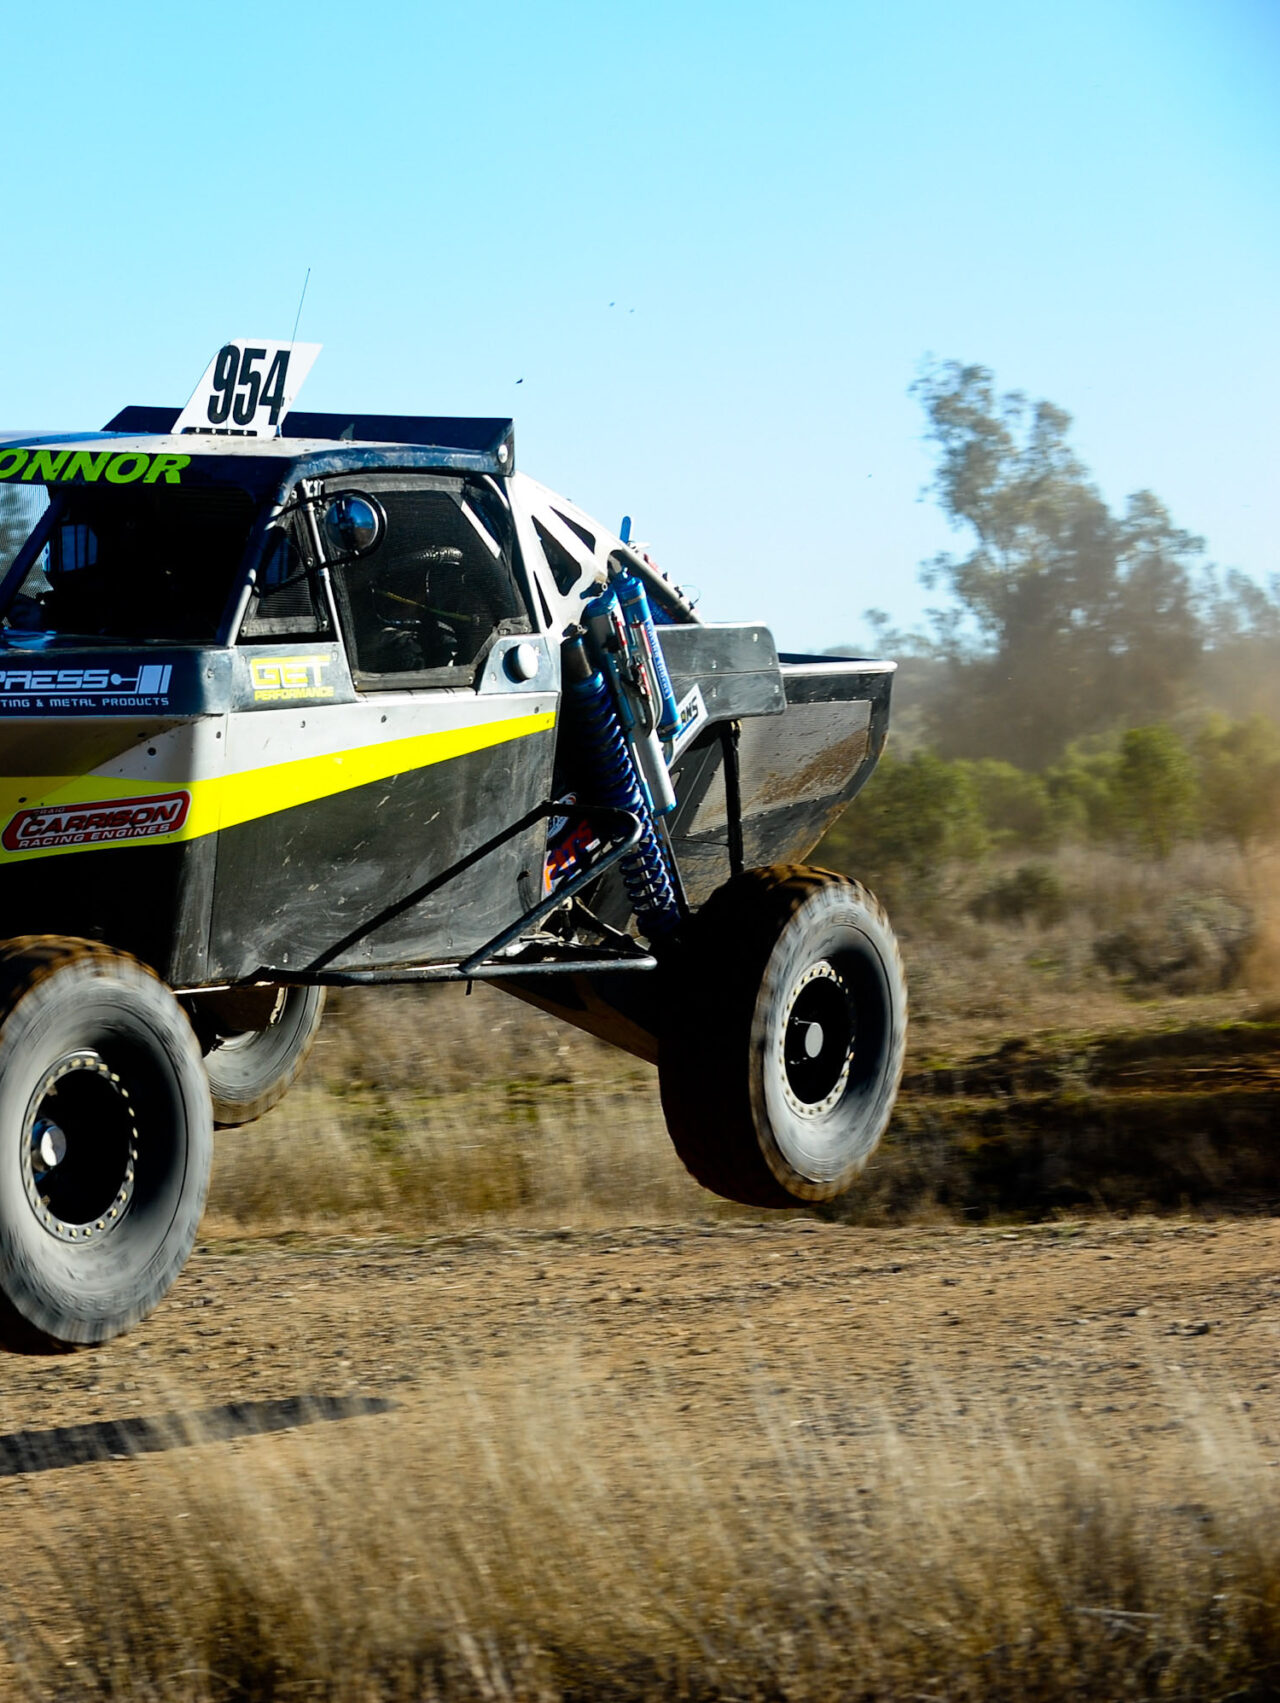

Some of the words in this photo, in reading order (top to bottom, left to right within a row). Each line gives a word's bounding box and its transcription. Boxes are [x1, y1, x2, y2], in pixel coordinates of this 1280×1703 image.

[207, 344, 292, 426] 954
[250, 655, 332, 690] GET
[36, 699, 44, 708] &
[49, 698, 96, 707] METAL
[102, 697, 170, 707] PRODUCTS
[254, 686, 335, 702] PERFORMANCE
[18, 833, 86, 848] RACING
[90, 823, 171, 840] ENGINES
